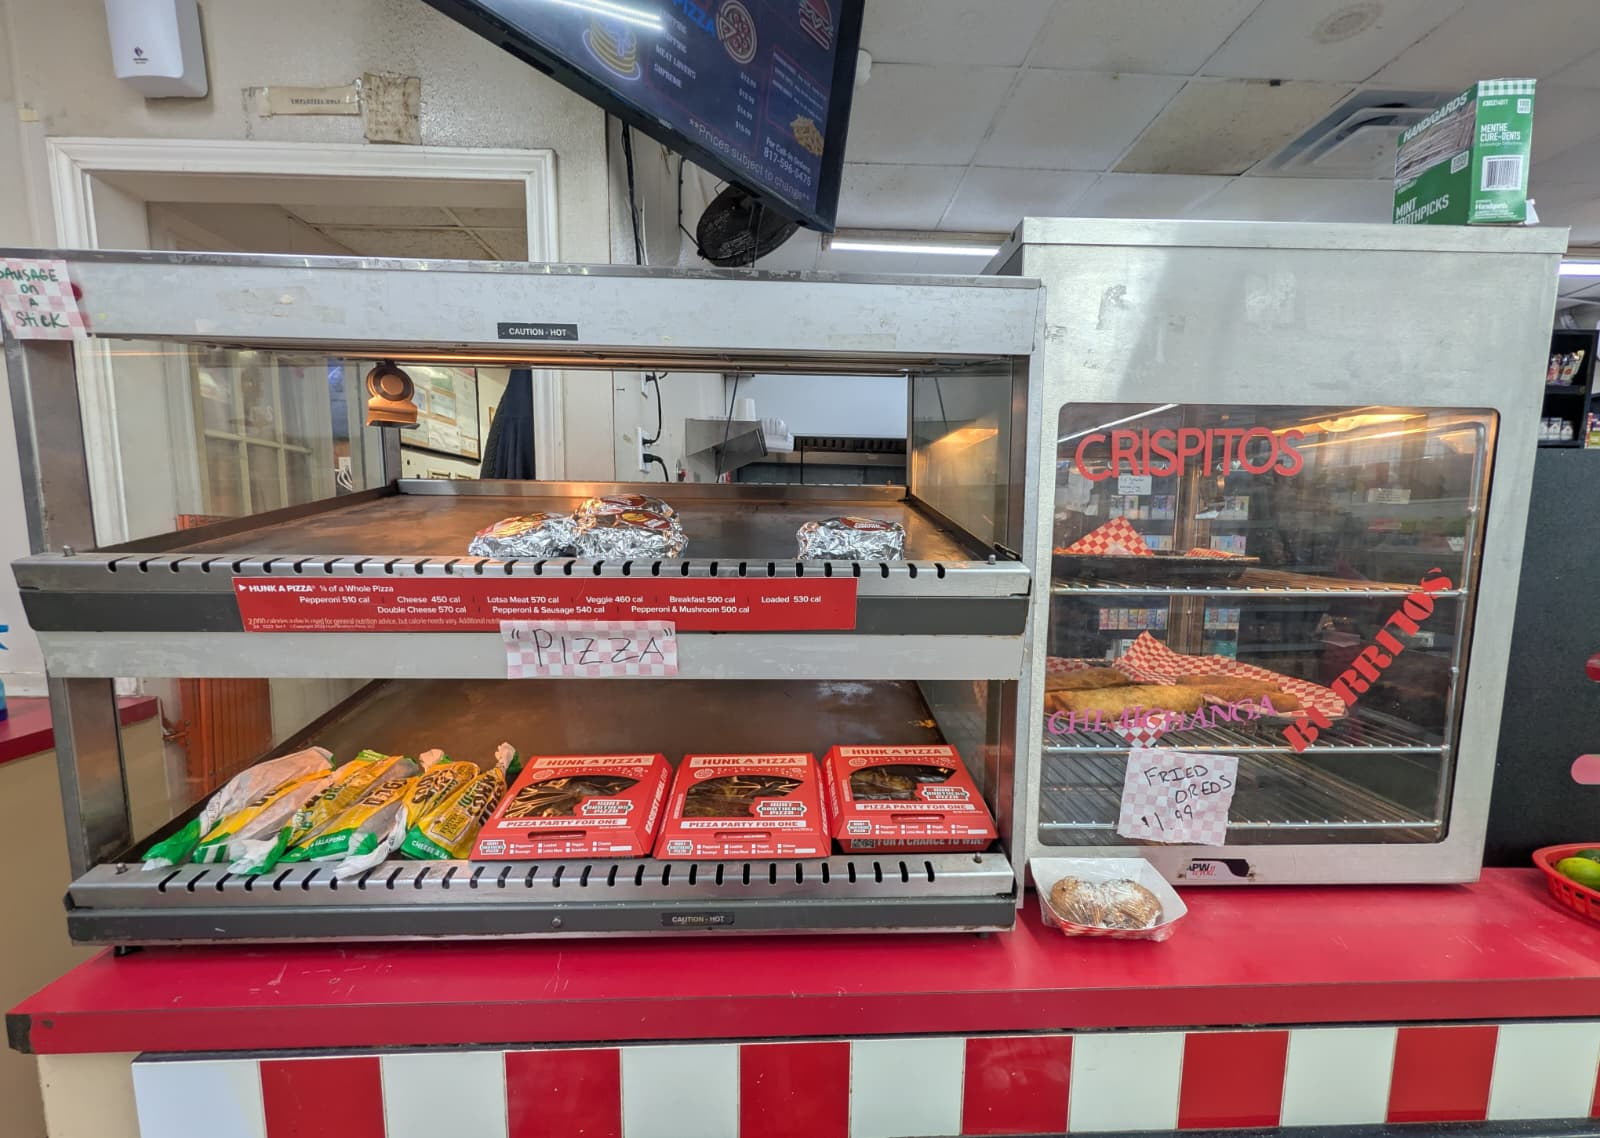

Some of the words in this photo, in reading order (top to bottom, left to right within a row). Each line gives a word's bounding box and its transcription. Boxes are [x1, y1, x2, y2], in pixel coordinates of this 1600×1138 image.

[1480, 123, 1508, 133] MENTHE
[1395, 197, 1418, 219] MINT
[508, 327, 544, 336] CAUTION
[550, 328, 567, 337] HOT
[1075, 426, 1305, 482] CRISPITOS
[249, 584, 277, 593] HUNK
[278, 584, 286, 593] A
[329, 584, 337, 592] of
[345, 584, 371, 593] Whole
[372, 584, 394, 593] Pizza
[299, 596, 341, 605] Pepperoni
[358, 596, 370, 604] cal
[548, 596, 559, 604] cal
[585, 596, 613, 605] Veggie
[669, 595, 706, 603] Breakfast
[810, 595, 821, 603] cal
[377, 606, 406, 614] Double
[407, 606, 437, 614] Cheese
[438, 606, 454, 614] 570
[455, 606, 467, 614] cal
[492, 606, 532, 615] Pepperoni
[533, 606, 539, 614] &
[541, 606, 575, 615] Sausage
[593, 606, 605, 614] cal
[631, 605, 670, 614] Pepperoni
[721, 606, 738, 614] 500
[738, 606, 750, 614] cal
[546, 759, 585, 767] HUNK
[743, 757, 754, 765] A
[756, 757, 796, 765] PIZZA
[1144, 764, 1209, 787] FRIED
[506, 820, 537, 828] PIZZA
[411, 840, 435, 855] CHEESE
[671, 916, 705, 924] CAUTION
[709, 915, 725, 923] HOT
